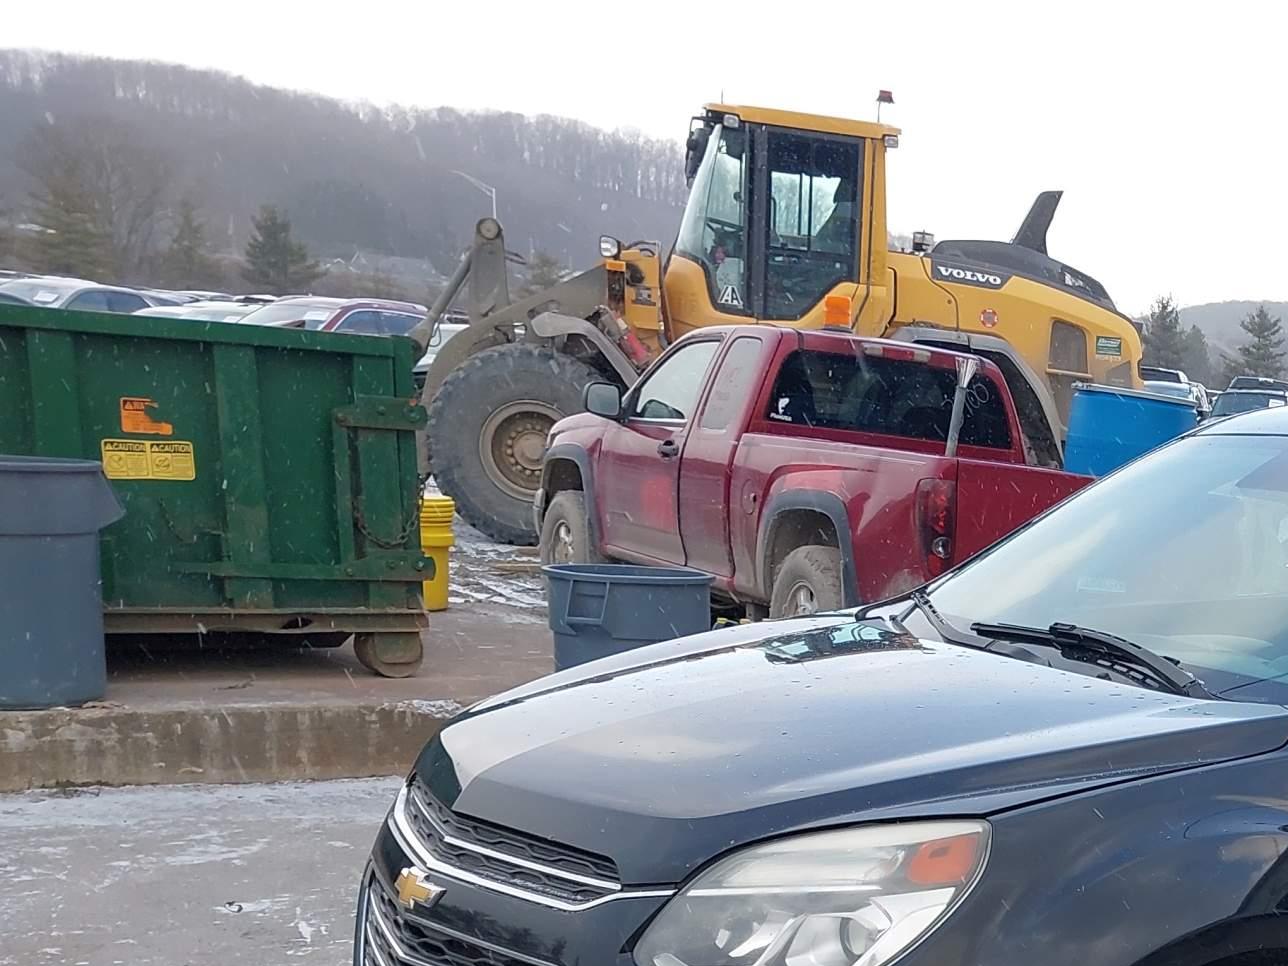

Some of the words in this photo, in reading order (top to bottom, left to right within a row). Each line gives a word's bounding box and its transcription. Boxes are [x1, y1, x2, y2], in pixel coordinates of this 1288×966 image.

[937, 265, 1002, 285] VOLVO
[112, 442, 145, 452] CAUTION
[159, 443, 191, 453] CAUTION
